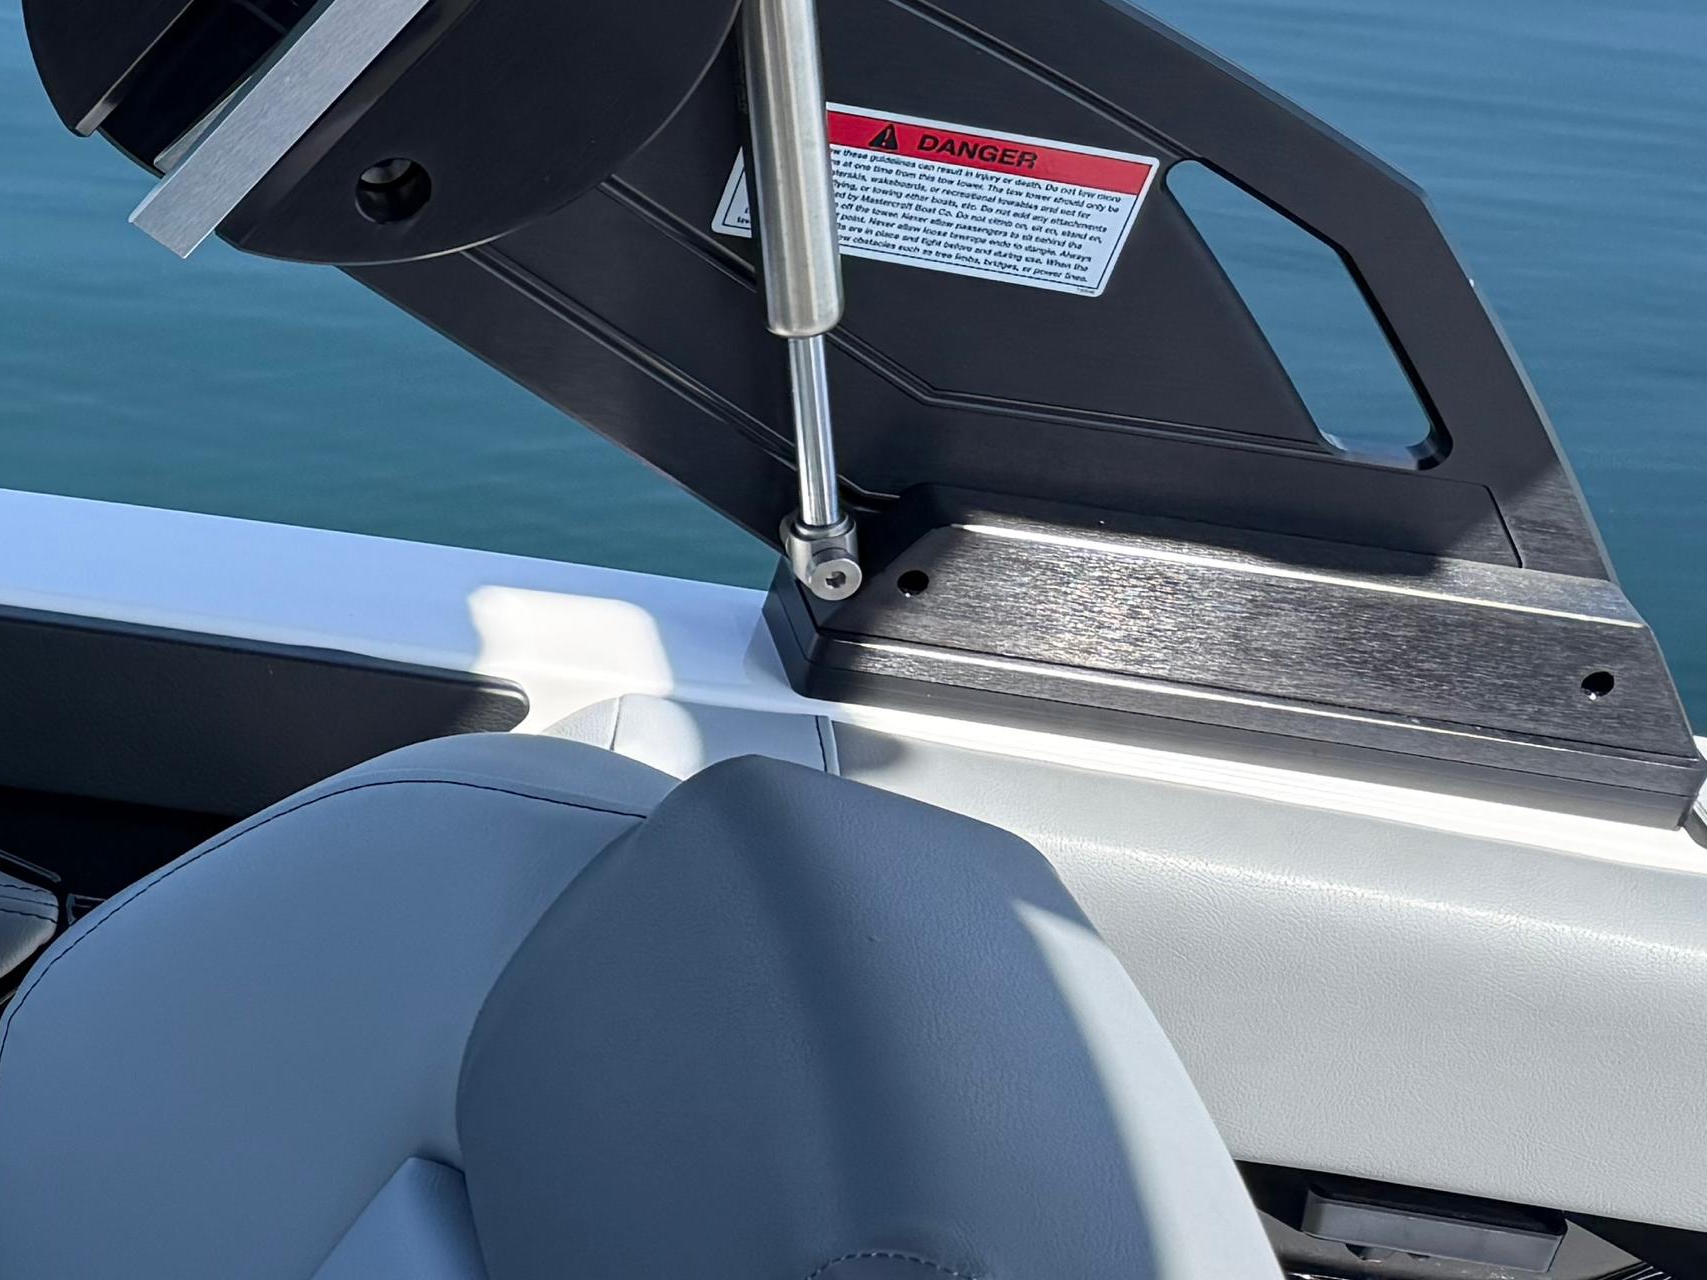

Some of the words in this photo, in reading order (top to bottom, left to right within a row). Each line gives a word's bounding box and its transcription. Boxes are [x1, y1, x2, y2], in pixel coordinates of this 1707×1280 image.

[915, 133, 1039, 169] DANGER
[916, 162, 935, 171] can
[935, 165, 963, 176] result
[1001, 176, 1012, 184] or
[1044, 184, 1059, 192] Do
[928, 185, 940, 193] or
[986, 184, 1004, 193] The
